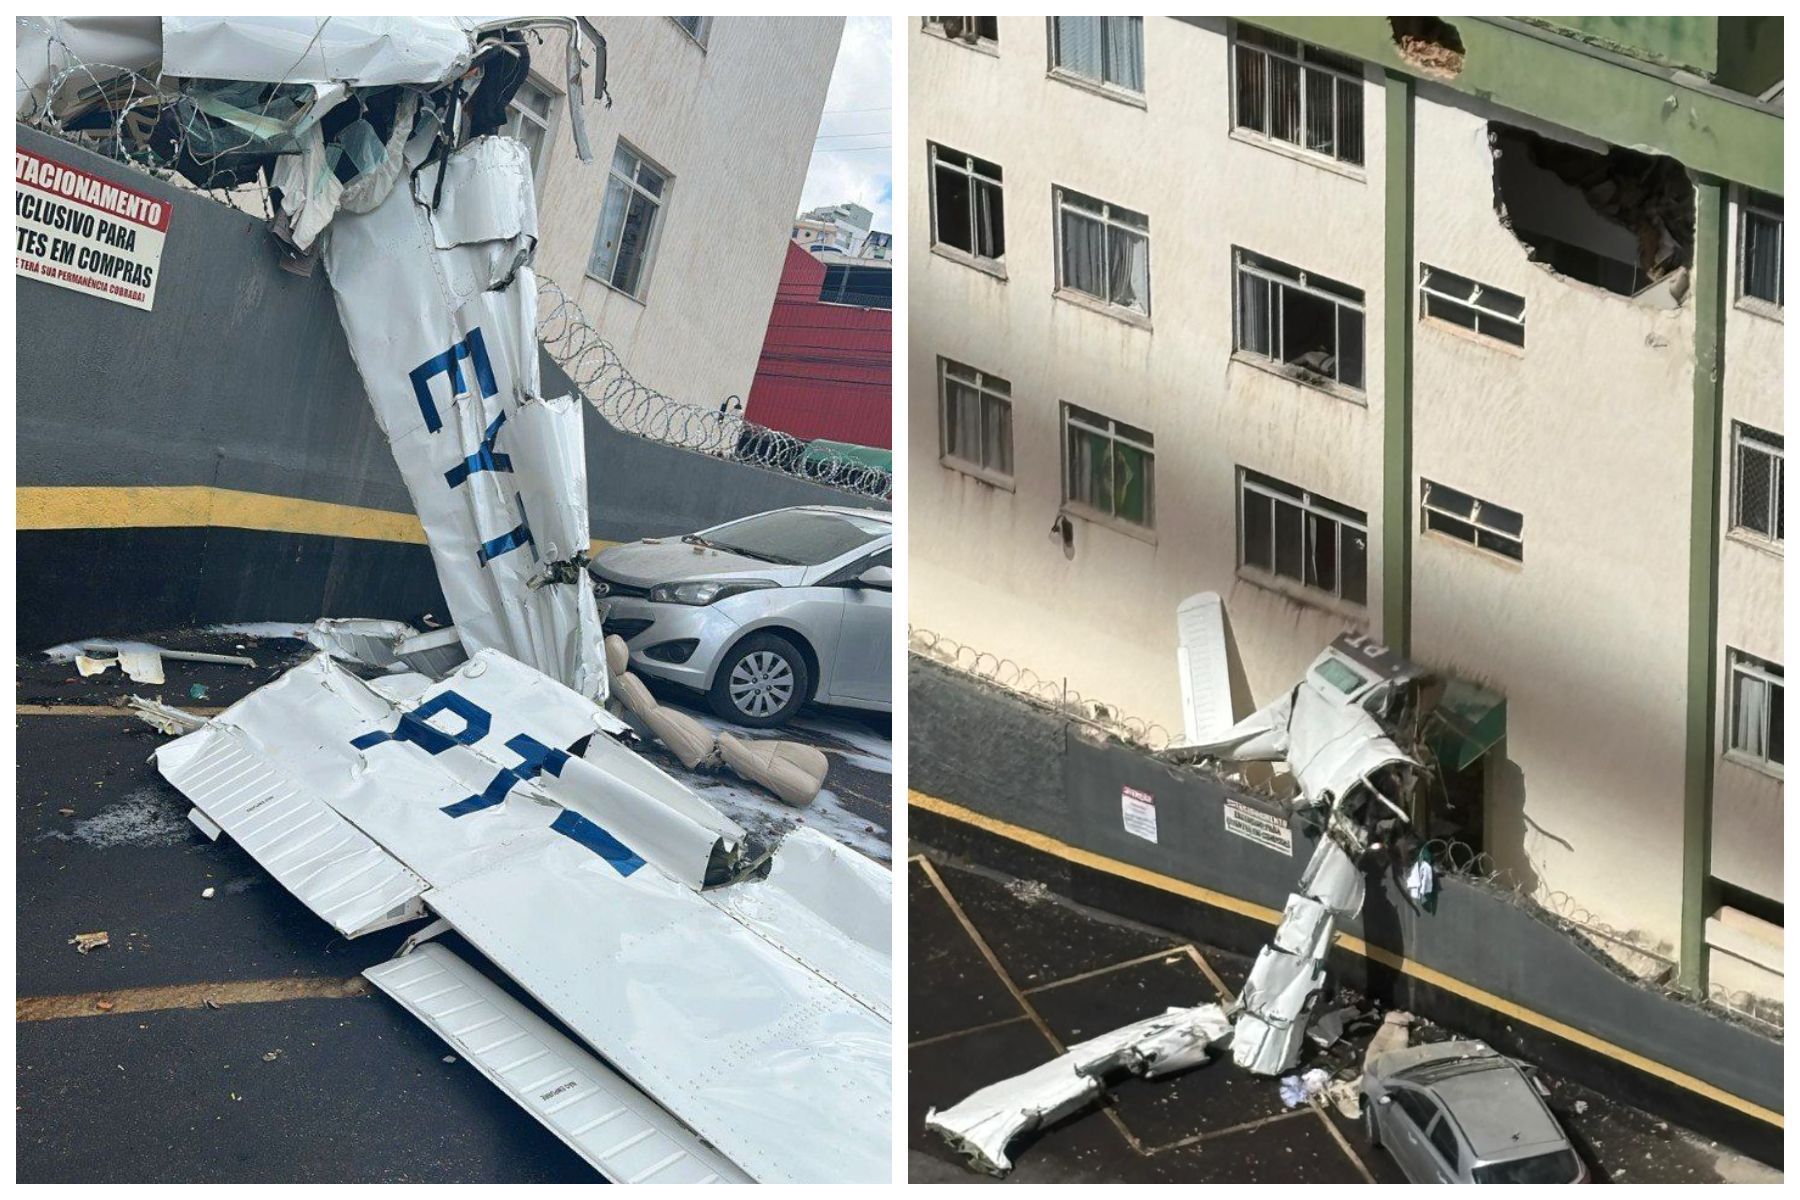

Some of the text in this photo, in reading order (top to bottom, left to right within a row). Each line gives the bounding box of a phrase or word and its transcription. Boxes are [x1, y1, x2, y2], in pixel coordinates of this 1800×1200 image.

[95, 220, 137, 252] PARA
[16, 226, 153, 288] TES EM COMPRAS
[20, 259, 40, 273] TERÁ
[41, 264, 57, 278] SUA
[57, 269, 108, 292] PERMANÊNCIA
